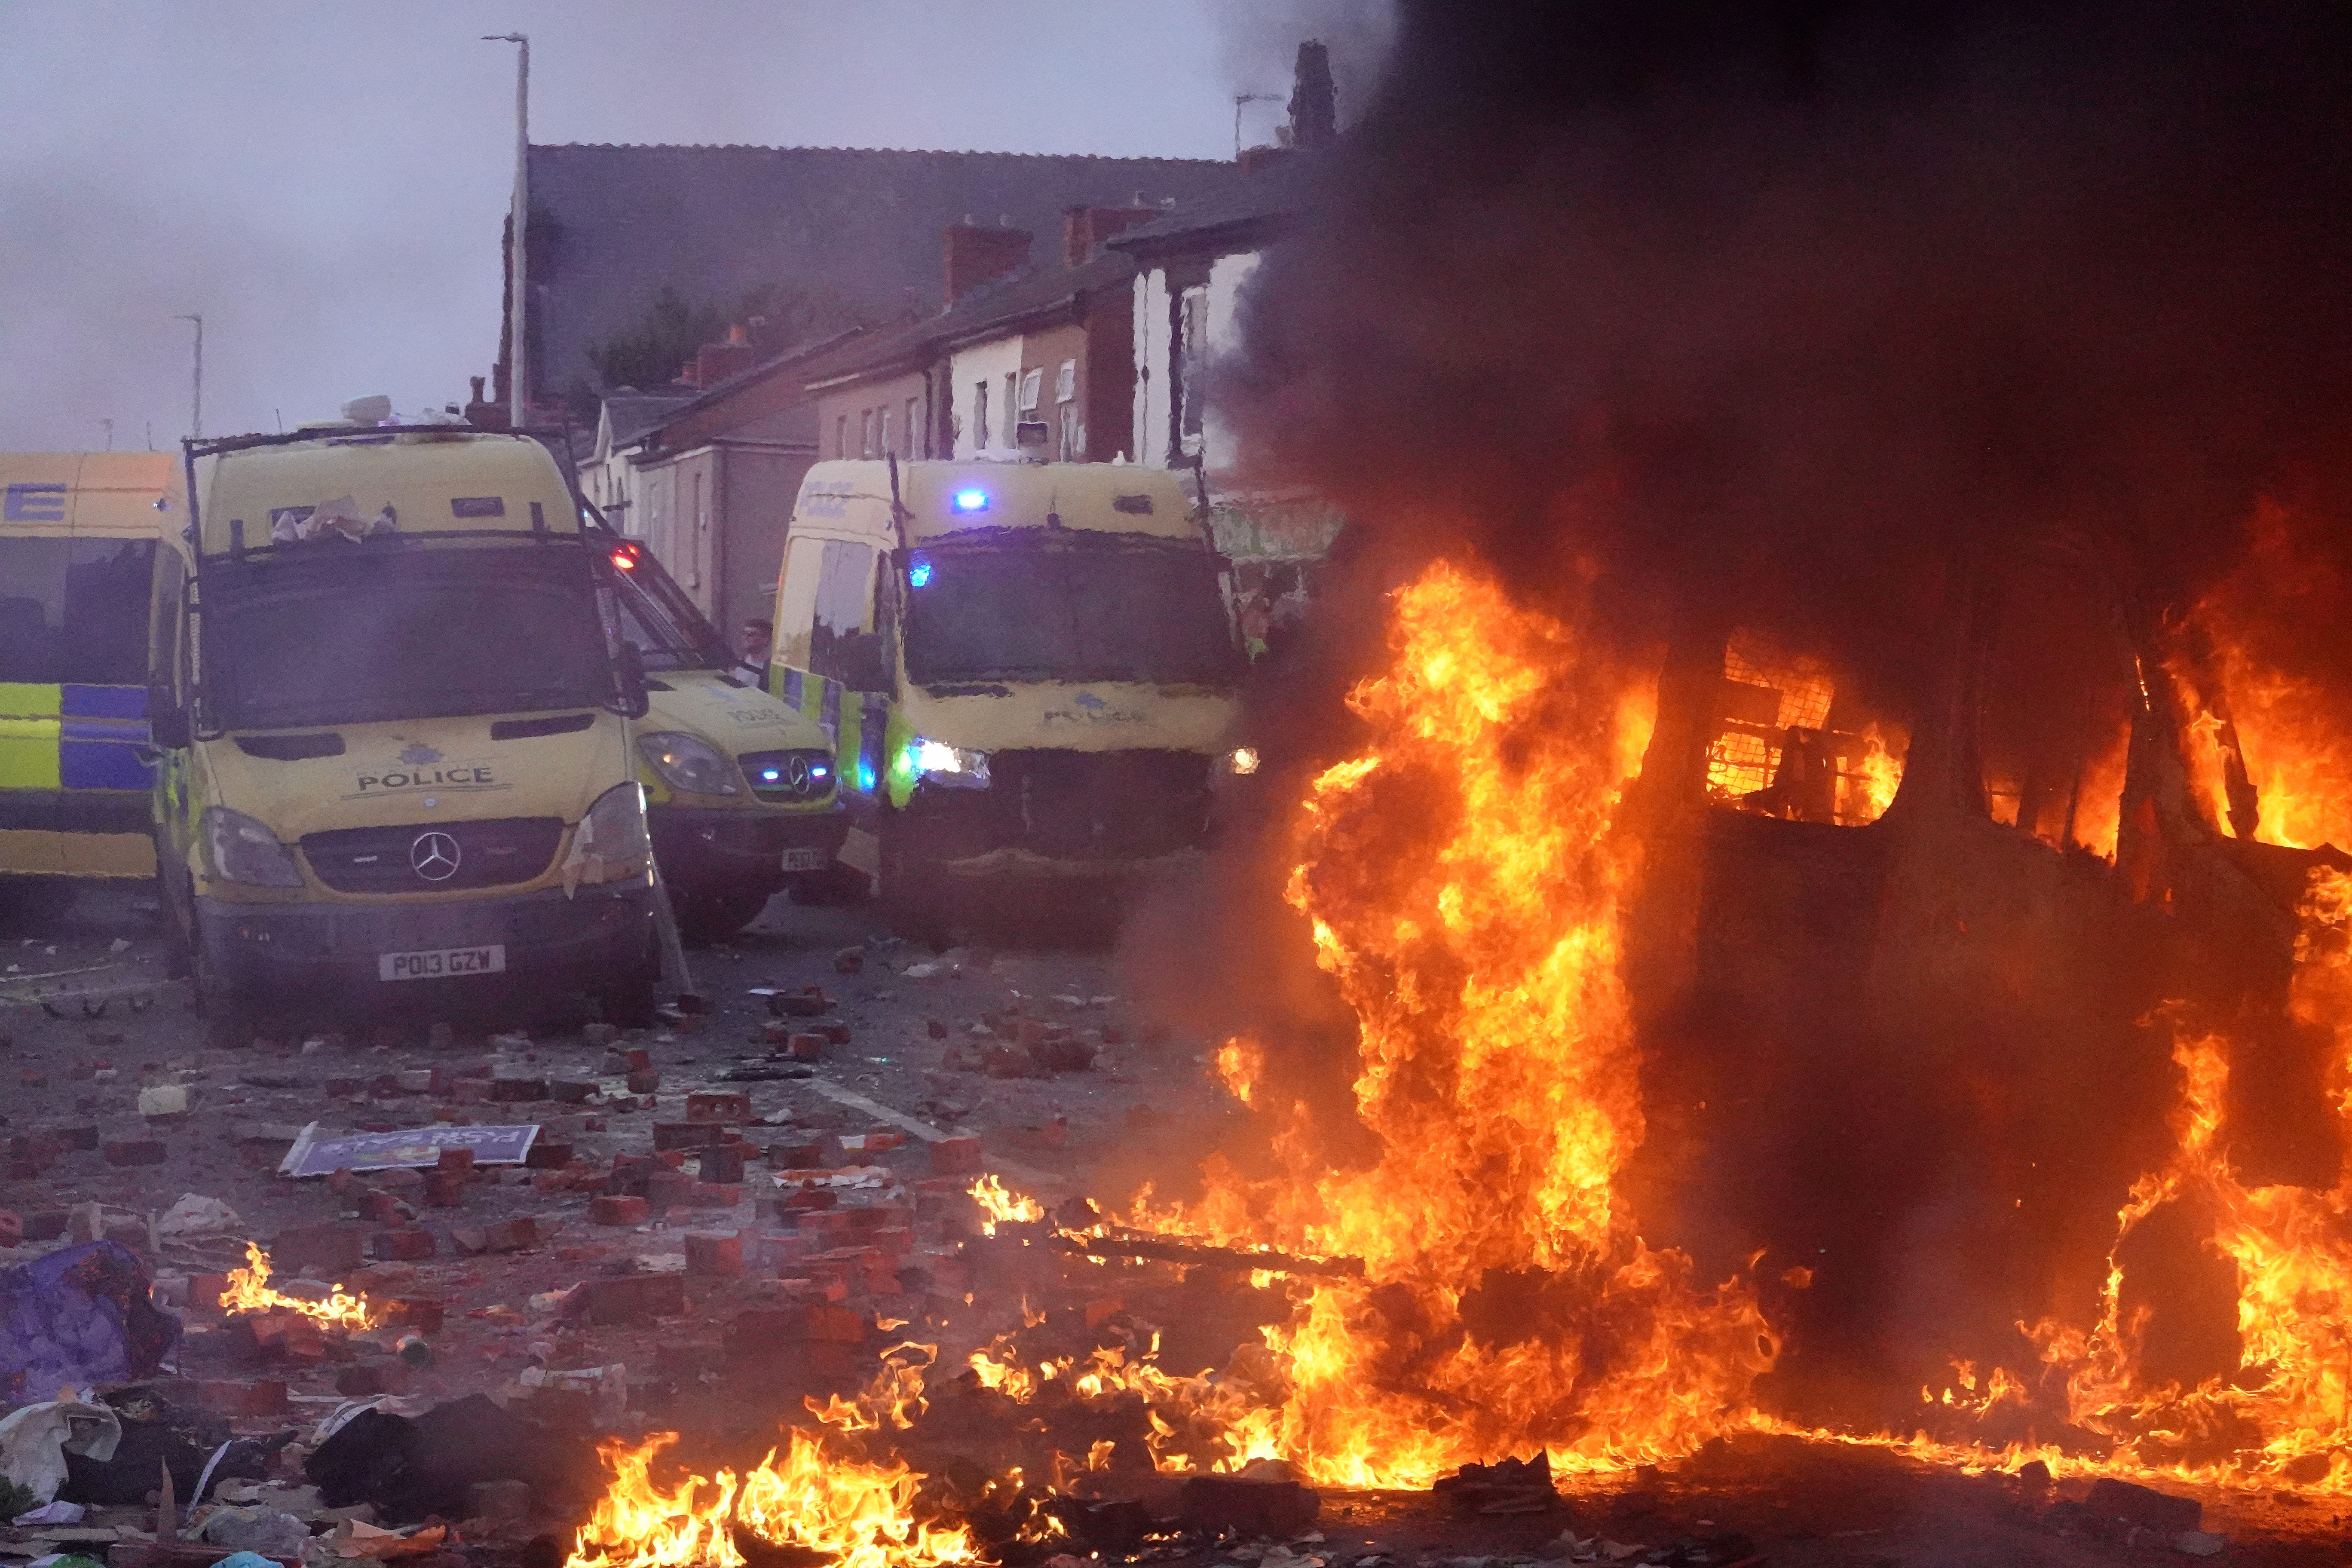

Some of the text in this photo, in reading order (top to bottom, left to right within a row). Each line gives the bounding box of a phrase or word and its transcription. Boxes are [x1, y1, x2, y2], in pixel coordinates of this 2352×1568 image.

[358, 767, 493, 791] POLICE
[393, 950, 490, 976] PO13 GZW
